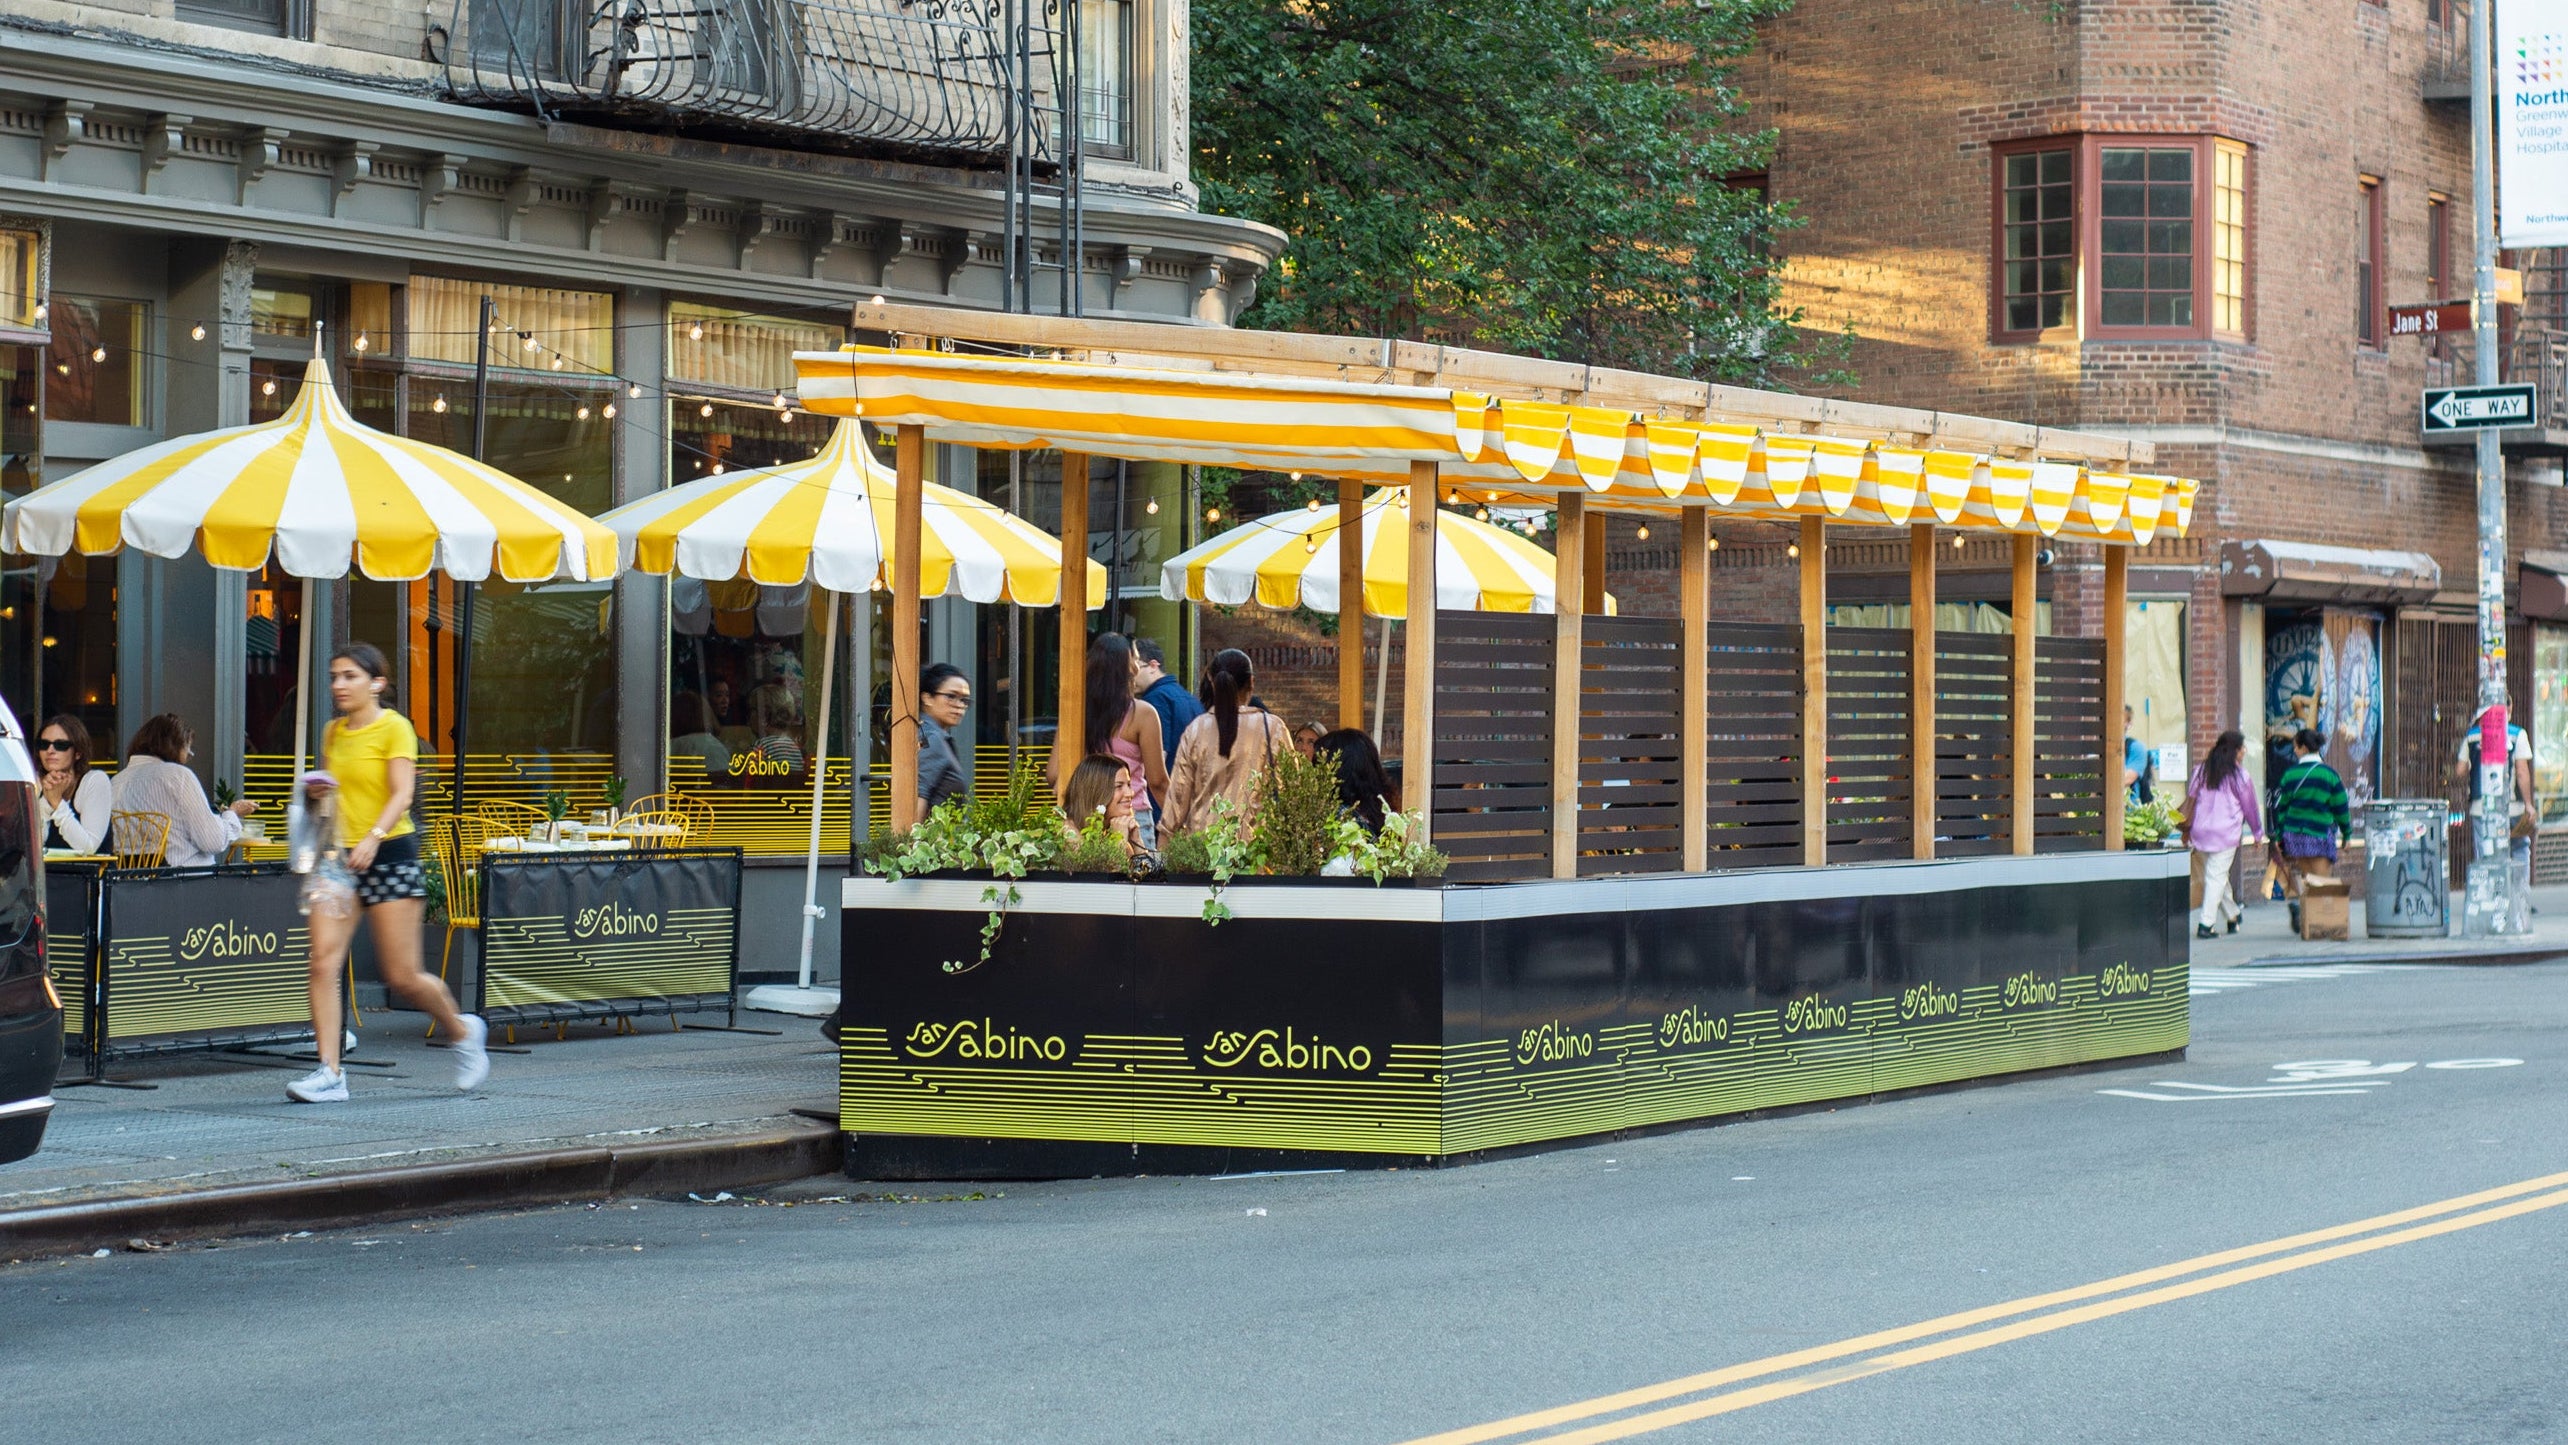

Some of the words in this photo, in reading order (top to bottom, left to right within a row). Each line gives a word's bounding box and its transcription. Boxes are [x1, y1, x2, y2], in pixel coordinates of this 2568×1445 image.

[2516, 126, 2562, 138] Village
[2392, 311, 2422, 334] Jane
[2425, 309, 2438, 332] St
[2442, 400, 2472, 418] ONE
[2487, 398, 2520, 415] WAY
[728, 749, 790, 776] Sabino
[574, 900, 658, 938] Sabino
[575, 908, 597, 927] San
[180, 918, 277, 960] Sabino
[181, 928, 207, 948] San
[2004, 969, 2056, 1007] Sabino
[2101, 960, 2149, 997] Sabino
[1784, 992, 1847, 1033] Sabino
[1901, 980, 1958, 1020] Sabino
[905, 1017, 1066, 1061] Sabino
[906, 1022, 948, 1045] San
[1203, 1030, 1247, 1054] San
[1517, 1029, 1538, 1052] San
[1517, 1019, 1593, 1065] Sabino
[1659, 1004, 1728, 1048] Sabino
[1203, 1025, 1372, 1071] Sabino
